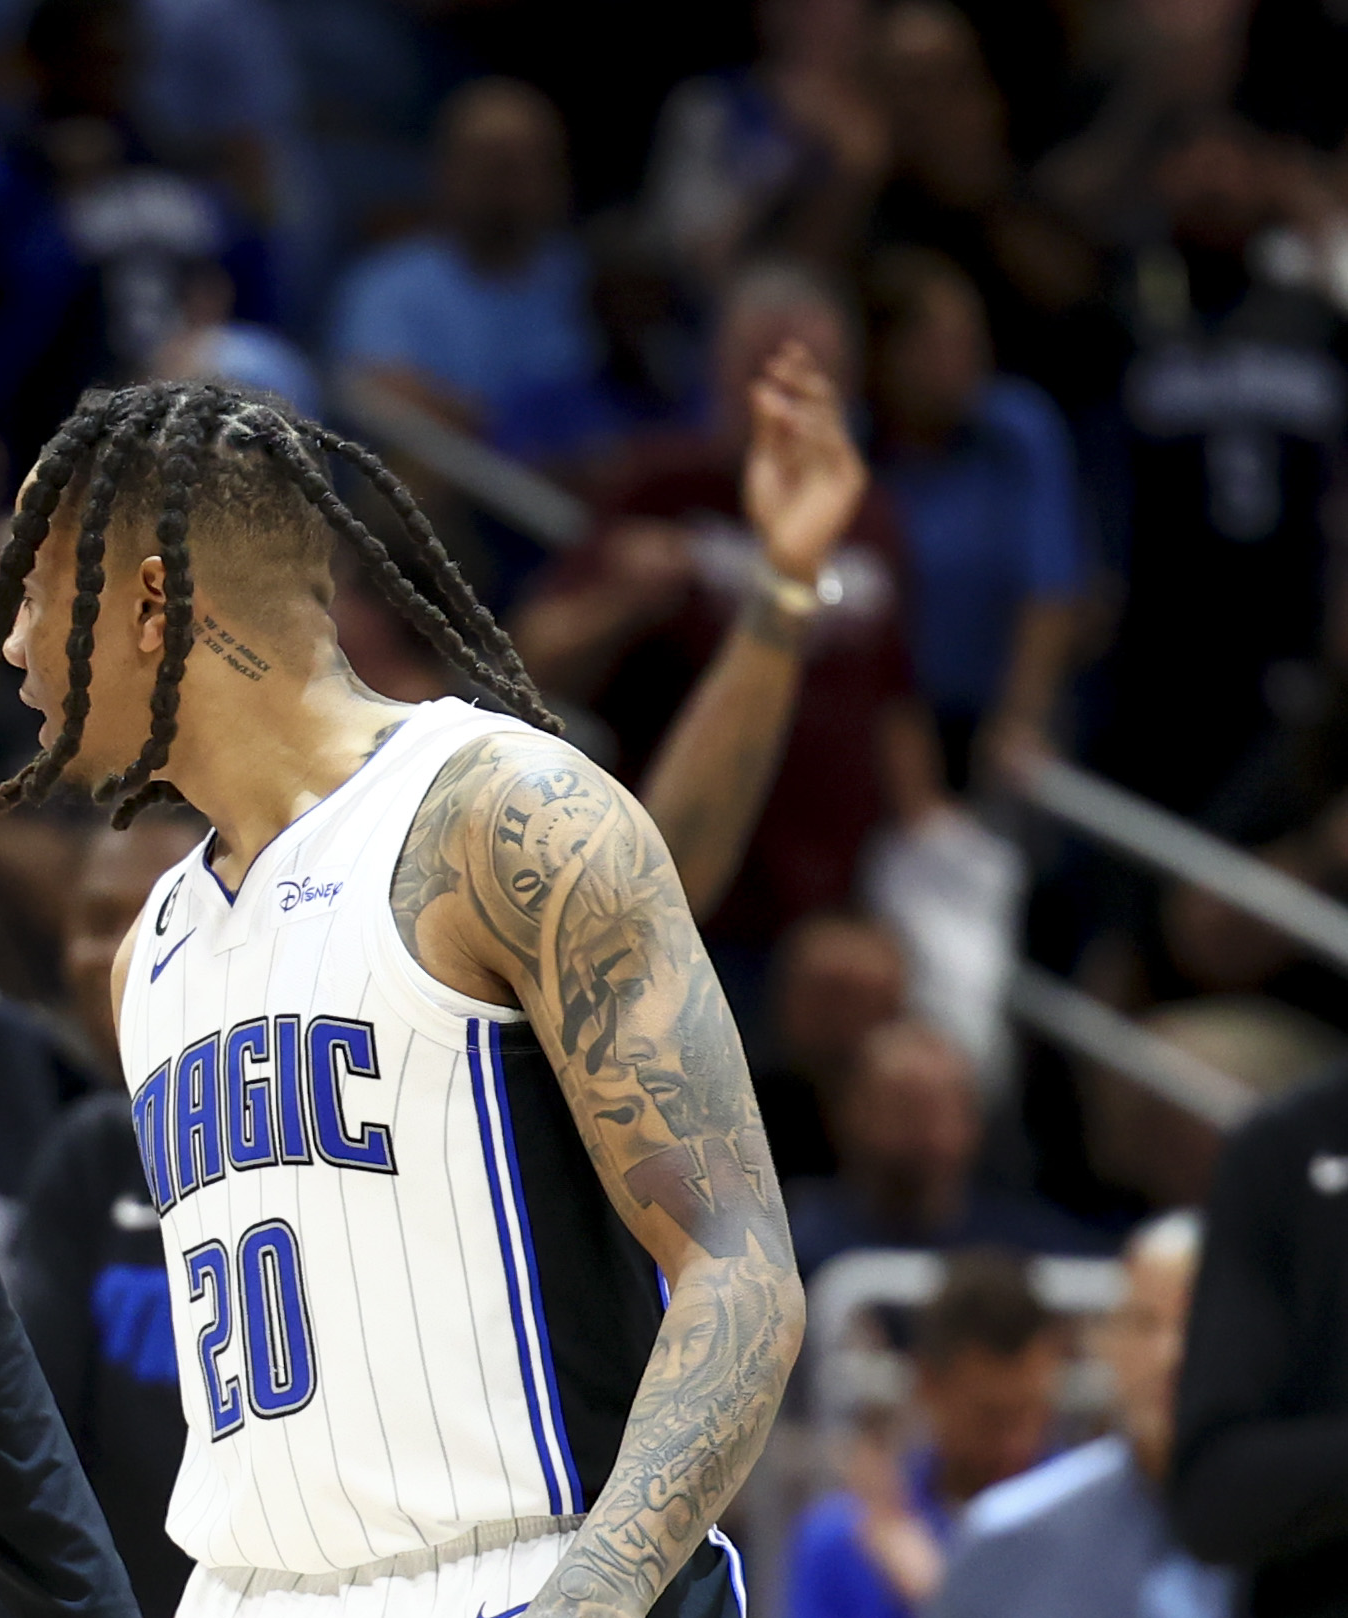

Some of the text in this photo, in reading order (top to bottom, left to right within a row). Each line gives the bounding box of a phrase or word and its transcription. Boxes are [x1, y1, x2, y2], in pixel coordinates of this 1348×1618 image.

[533, 769, 590, 807] 12
[131, 1012, 399, 1219] MAGIC
[183, 1217, 317, 1443] 20
